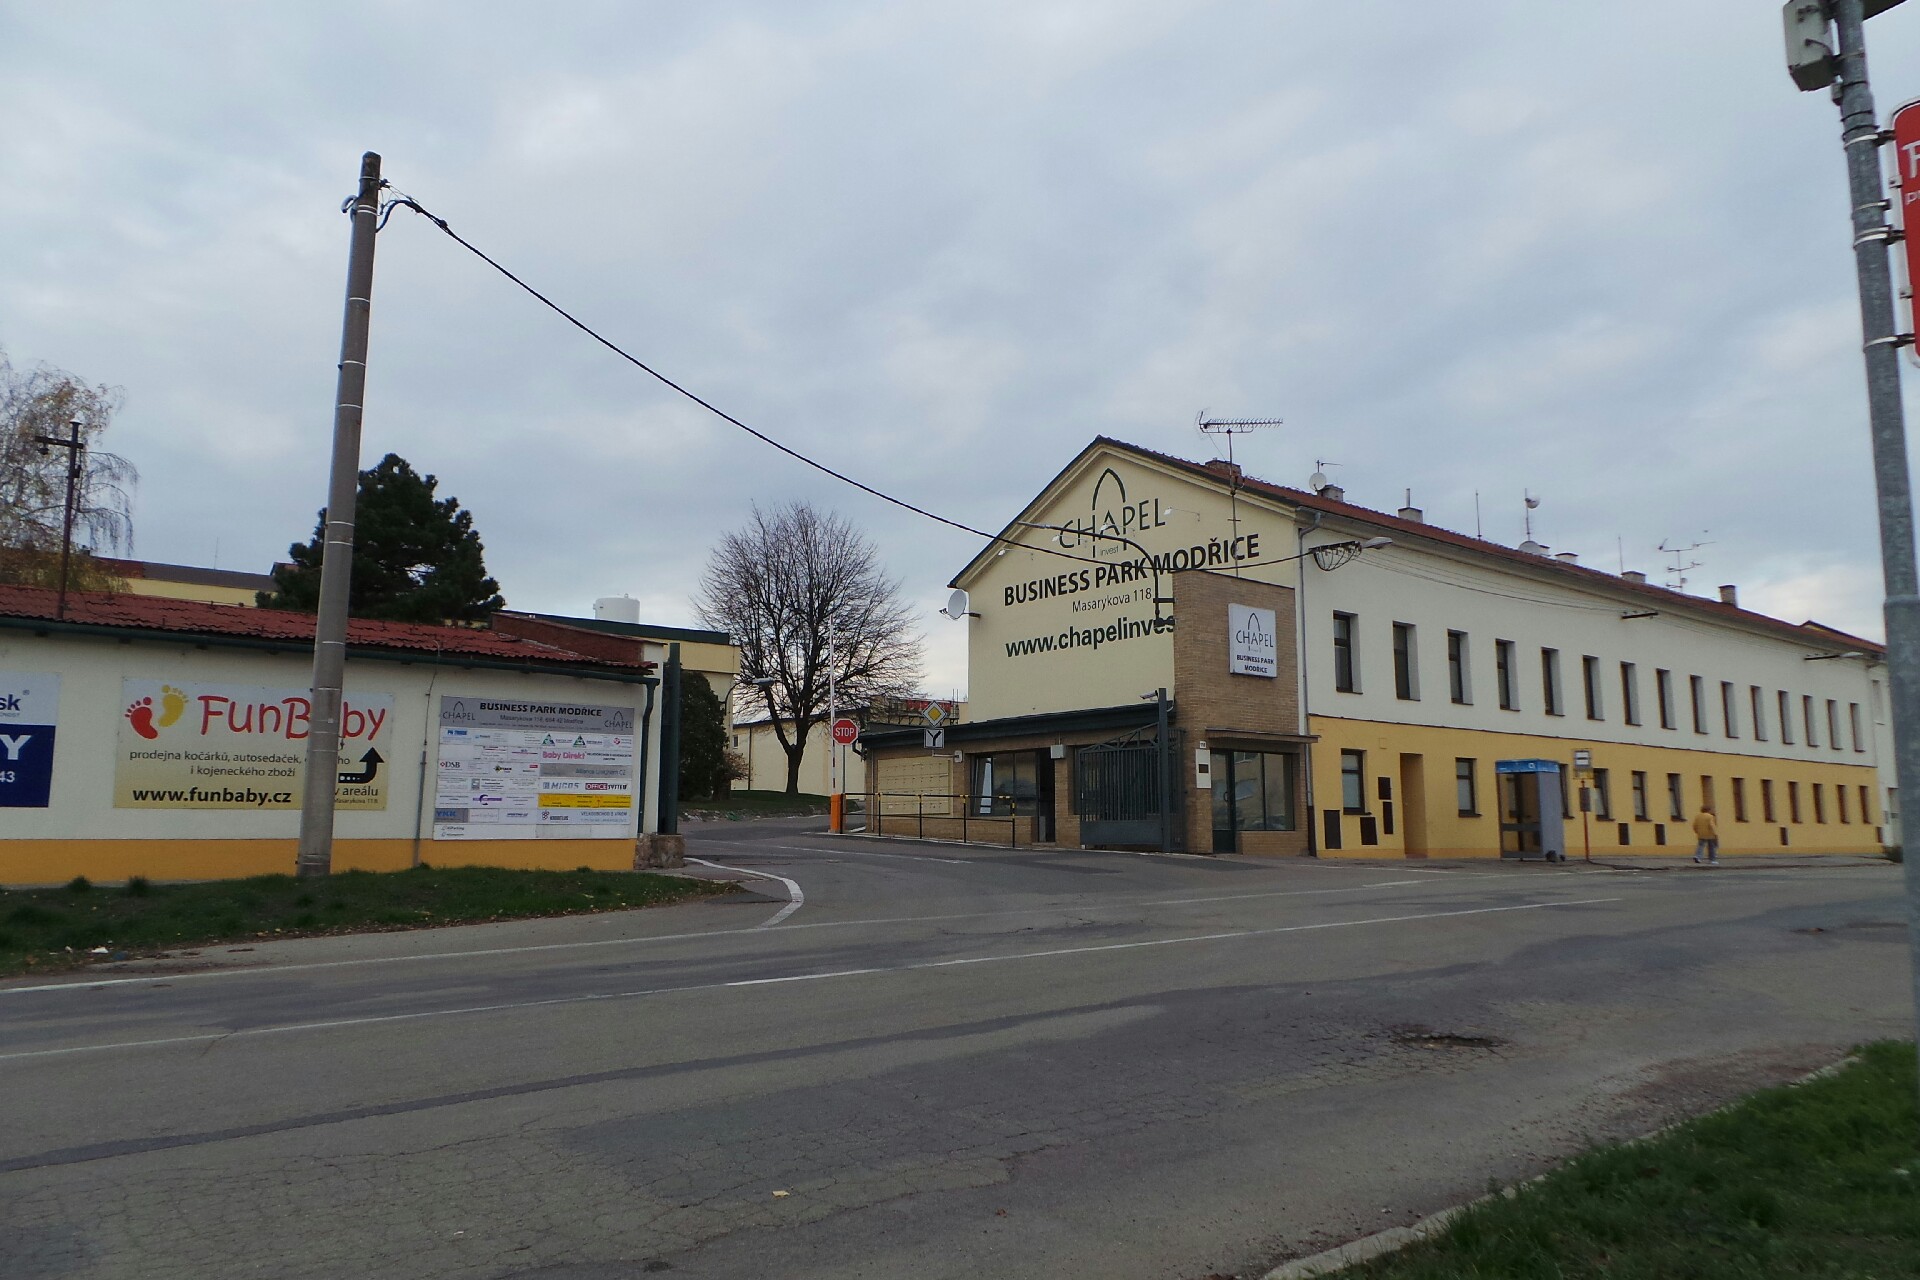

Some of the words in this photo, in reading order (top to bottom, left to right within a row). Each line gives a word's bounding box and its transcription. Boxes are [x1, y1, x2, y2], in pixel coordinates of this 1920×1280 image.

[1060, 498, 1165, 548] CHAPEL
[1004, 569, 1090, 606] BUSINESS
[1096, 557, 1147, 588] PARK
[1154, 534, 1259, 575] MODŘICE
[1072, 593, 1130, 613] Masarykova
[1133, 588, 1152, 601] 118
[1236, 630, 1274, 647] CHAPEL
[1237, 655, 1260, 663] BUSINESS
[442, 711, 476, 721] CHAPEL
[480, 702, 528, 712] BUSINESS
[530, 705, 556, 714] PARK
[558, 707, 602, 717] MODŘICE
[198, 695, 386, 741] FunBby
[604, 719, 633, 729] CHAPEL
[835, 727, 855, 737] STOP
[129, 750, 181, 761] prodejna
[233, 753, 302, 764] autosedaček,
[542, 751, 561, 760] Baby
[563, 751, 585, 759] Direkt
[190, 765, 194, 774] i
[197, 766, 265, 777] kojeneckého
[267, 768, 296, 777] zboží
[133, 787, 292, 806] www.funbaby.cz
[342, 786, 378, 796] areálu
